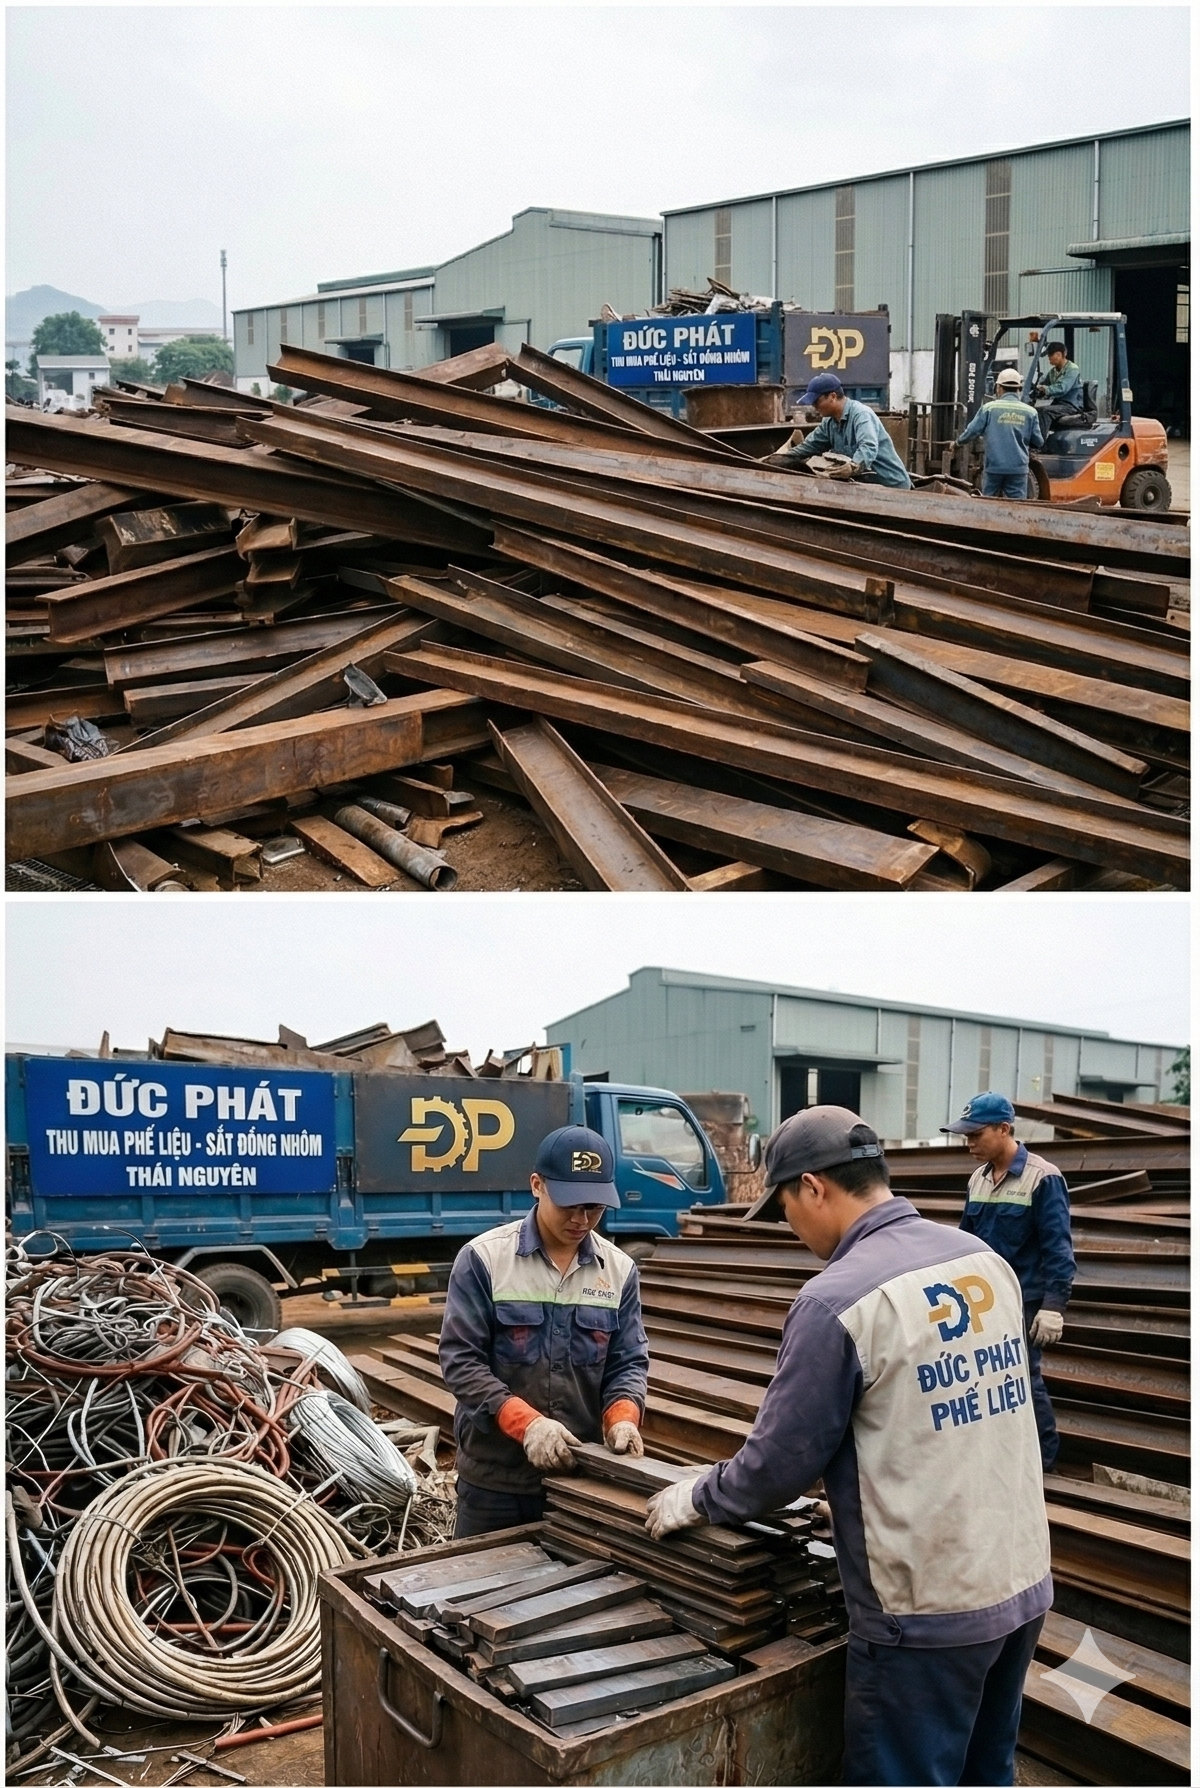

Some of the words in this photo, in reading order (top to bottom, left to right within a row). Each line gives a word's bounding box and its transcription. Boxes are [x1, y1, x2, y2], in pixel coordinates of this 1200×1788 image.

[623, 325, 667, 351] ĐỨC
[673, 320, 735, 348] PHÁT
[66, 1073, 168, 1118] ĐỨC
[184, 1080, 302, 1122] PHÁT
[46, 1129, 79, 1155] THU
[82, 1130, 121, 1155] MUA
[123, 1123, 155, 1155] PHẾ
[158, 1126, 192, 1161] LIỆU
[205, 1123, 234, 1157] SẮT
[280, 1128, 323, 1157] NHÔM
[126, 1162, 173, 1187] THÁI
[178, 1162, 257, 1187] NGUYÊN
[916, 1351, 971, 1394] ĐỨC
[973, 1333, 1022, 1377] PHÁT
[930, 1381, 983, 1432] PHẾ
[986, 1373, 1027, 1414] LIỆU
